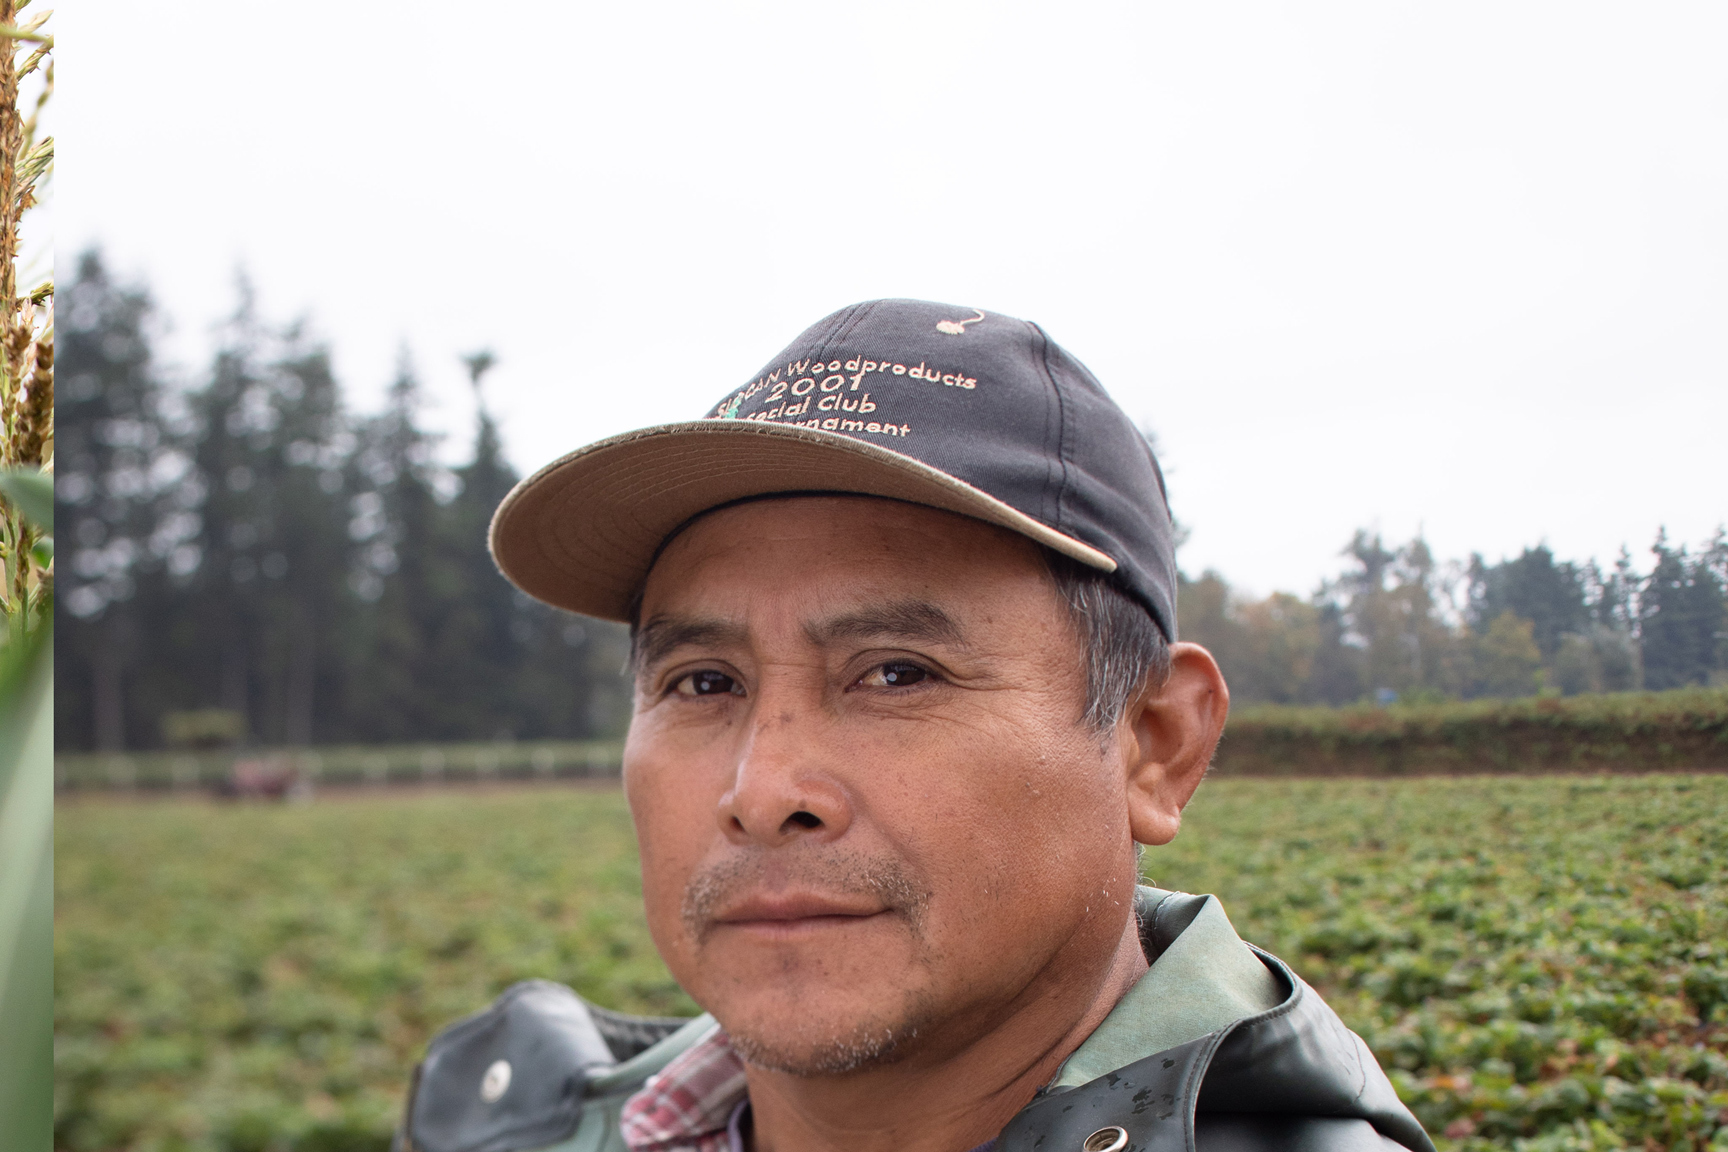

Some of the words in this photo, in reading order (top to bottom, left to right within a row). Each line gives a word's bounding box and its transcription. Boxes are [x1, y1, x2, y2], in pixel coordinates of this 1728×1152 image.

[786, 354, 978, 390] Woodproducts
[765, 373, 865, 404] 2001
[817, 392, 877, 414] Club
